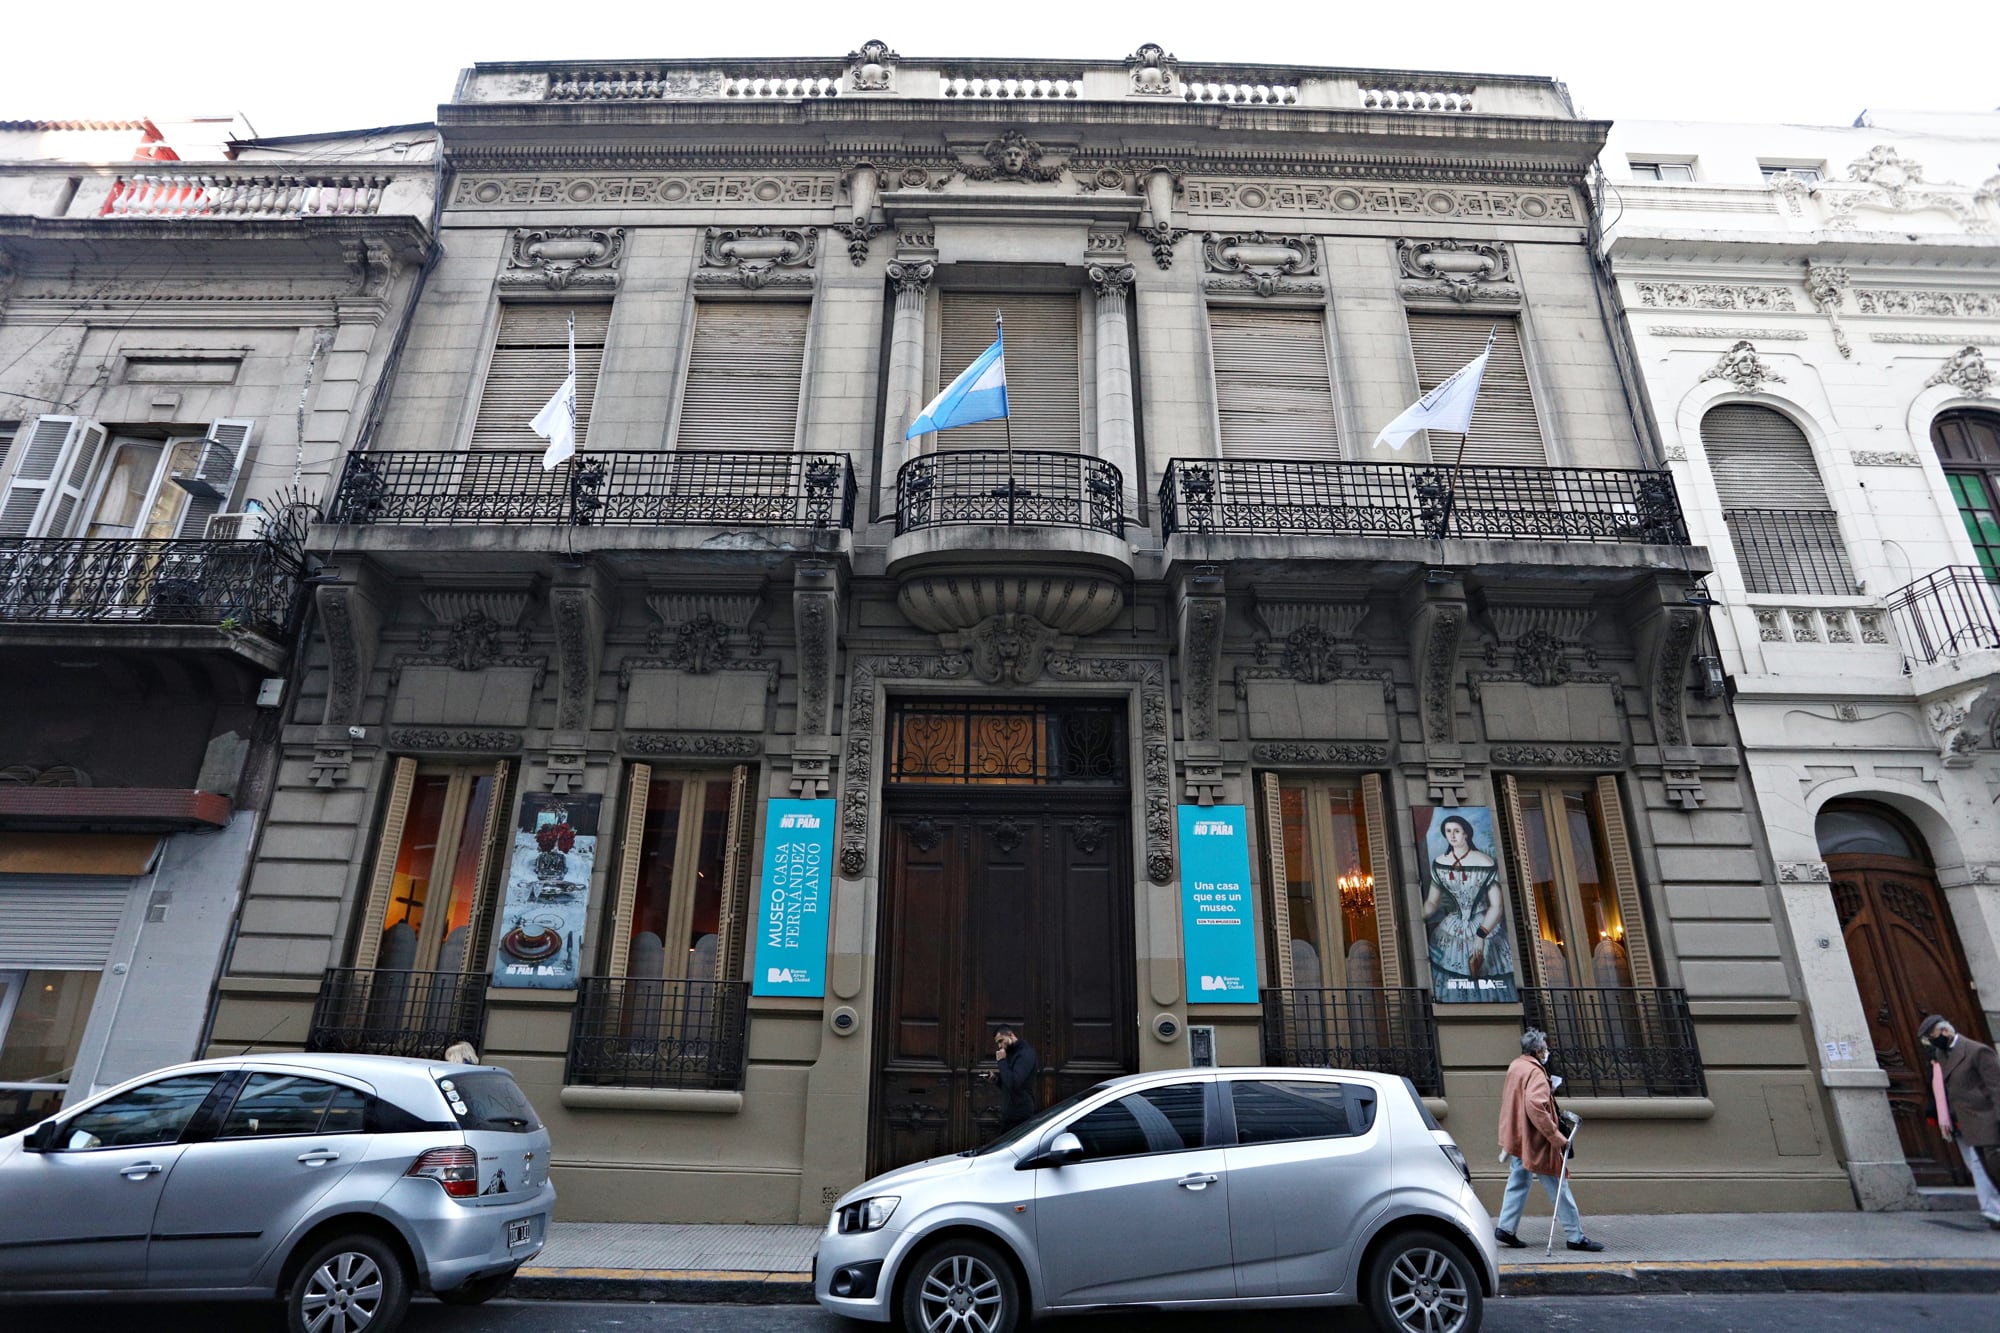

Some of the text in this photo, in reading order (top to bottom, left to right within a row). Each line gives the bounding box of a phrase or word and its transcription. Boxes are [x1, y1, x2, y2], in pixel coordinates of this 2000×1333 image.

[780, 817, 821, 829] NO PARA
[1193, 824, 1233, 836] NO PARA
[803, 842, 822, 914] BLANCO
[1194, 881, 1215, 890] Una
[767, 842, 790, 948] MUSEO CASA
[785, 842, 806, 949] FERNÁNDEZ
[1193, 893, 1242, 903] que es un
[1200, 904, 1237, 912] museo.
[537, 965, 555, 976] BA
[767, 967, 793, 983] BA
[1200, 975, 1227, 991] BA
[1478, 978, 1496, 990] BA
